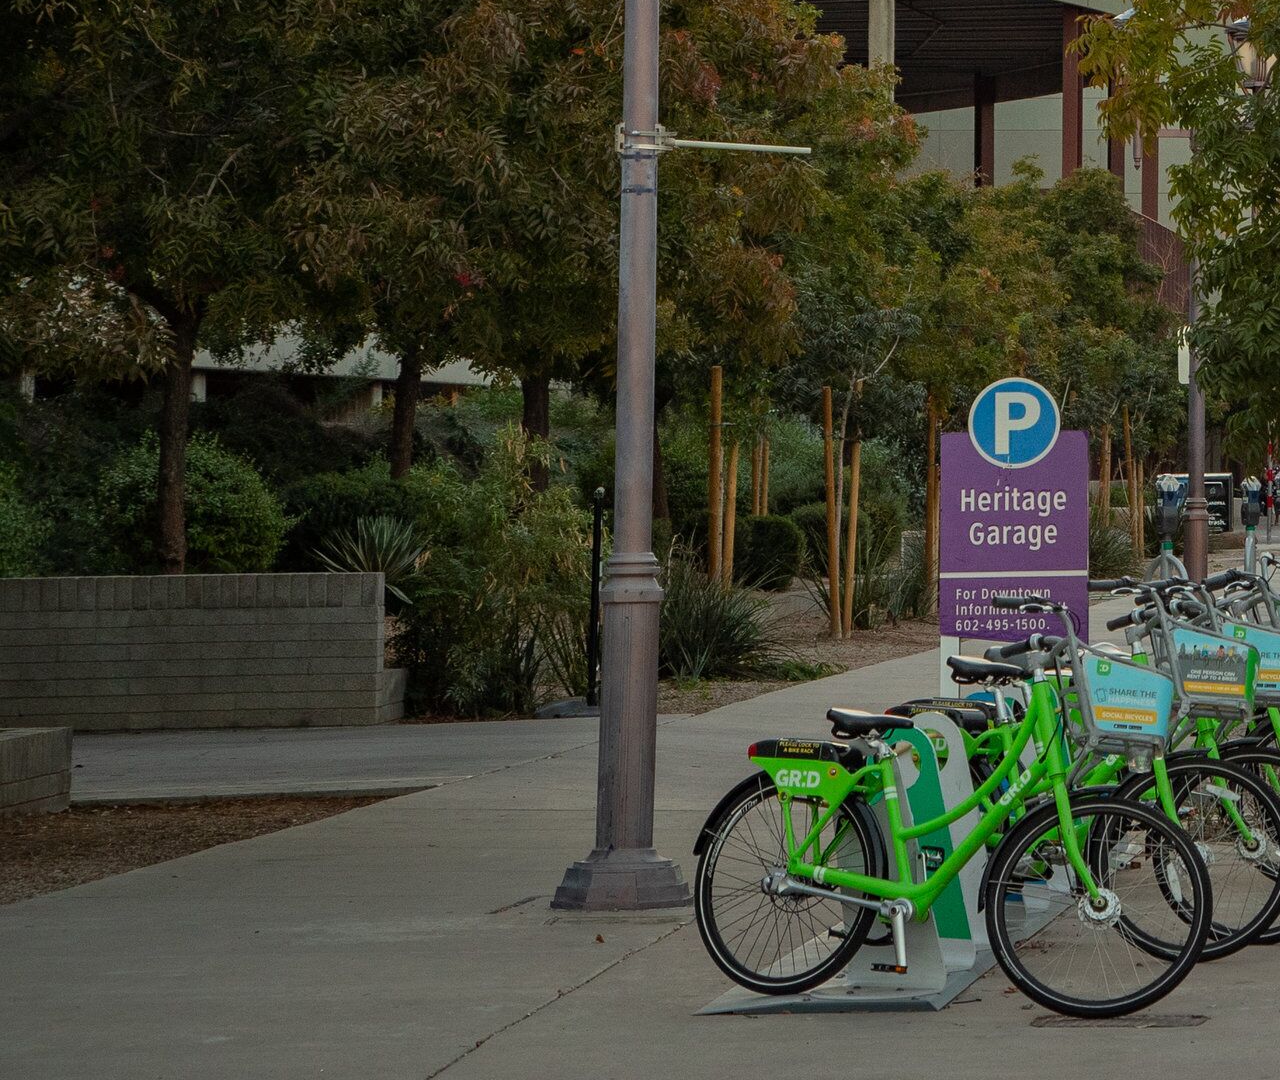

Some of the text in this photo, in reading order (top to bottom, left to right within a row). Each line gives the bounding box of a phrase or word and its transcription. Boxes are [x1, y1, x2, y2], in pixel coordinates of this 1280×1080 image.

[994, 391, 1041, 455] P
[961, 486, 1067, 517] Heritage
[969, 522, 1058, 551] Garage
[956, 588, 1051, 600] For Downtown
[955, 618, 1051, 631] 602-495-1500.
[1108, 688, 1157, 698] SHARE THE
[1102, 711, 1153, 721] SOCIAL BICYCLES
